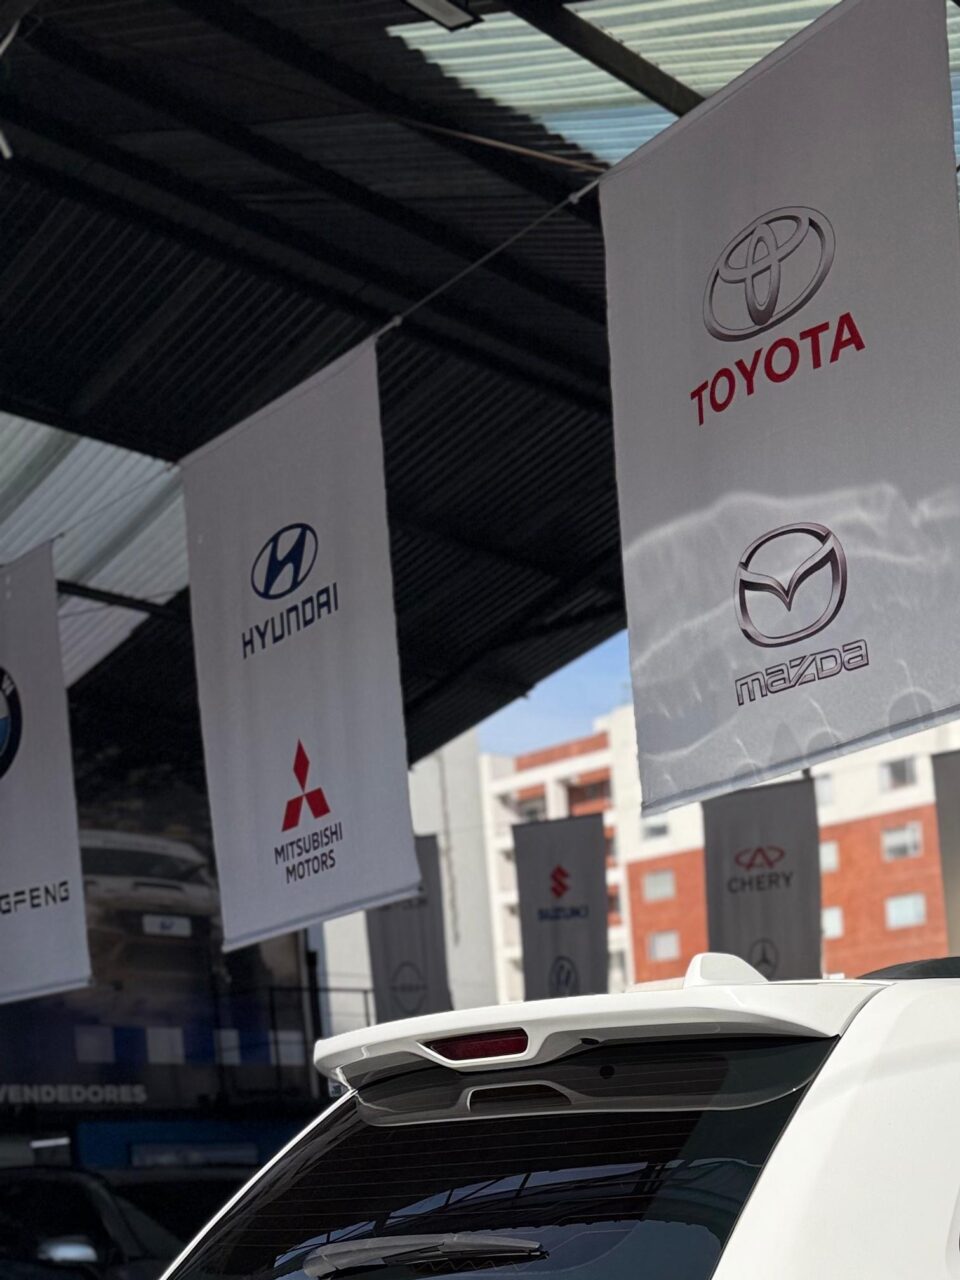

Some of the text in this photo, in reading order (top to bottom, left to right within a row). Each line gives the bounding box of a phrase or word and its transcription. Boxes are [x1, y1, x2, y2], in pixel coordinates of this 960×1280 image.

[690, 312, 866, 426] TOYOTA
[242, 582, 339, 659] HYUNDAI
[274, 821, 343, 865] MITSUBISHI
[286, 848, 336, 884] MOTORS
[727, 871, 793, 894] CHERY
